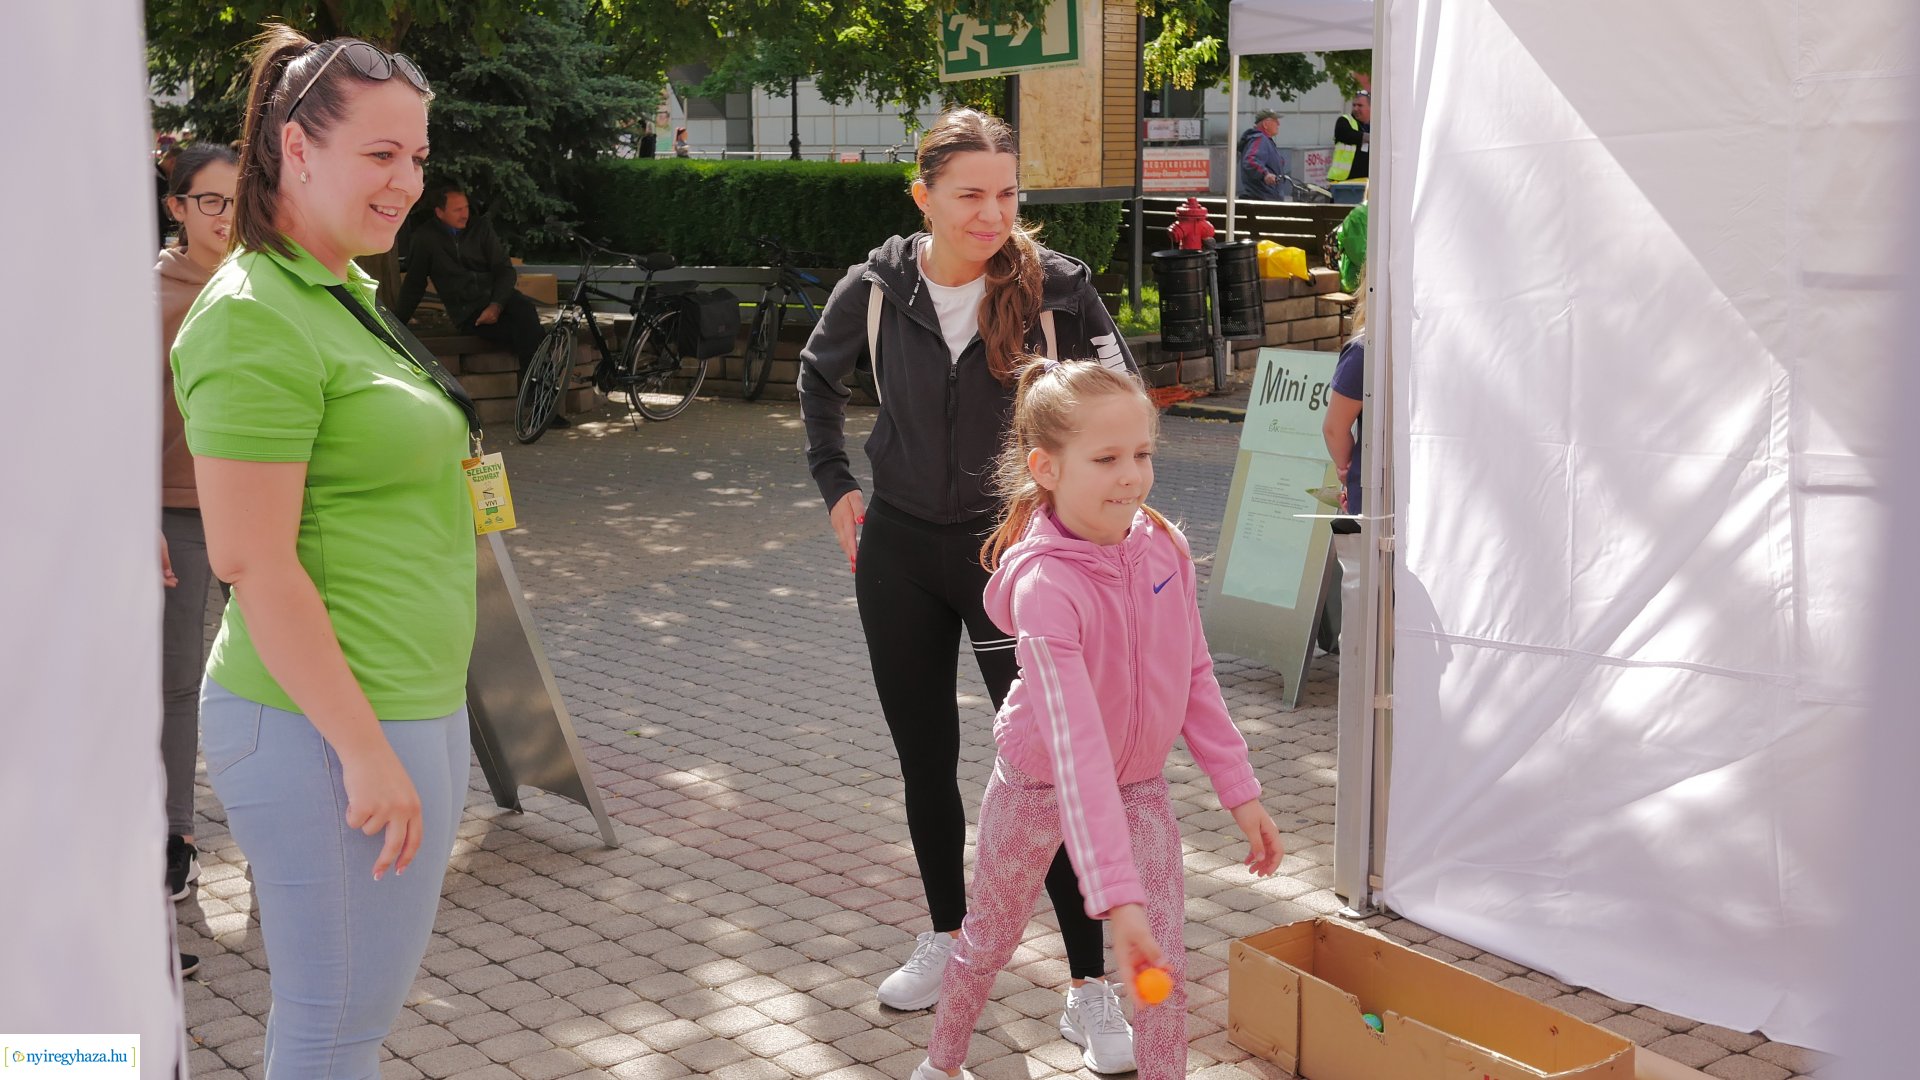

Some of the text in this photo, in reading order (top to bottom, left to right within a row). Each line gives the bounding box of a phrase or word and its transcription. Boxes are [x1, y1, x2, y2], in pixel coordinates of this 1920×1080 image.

[1259, 360, 1308, 406] Mini
[466, 463, 502, 476] SZELEKTÍV
[472, 471, 500, 483] SZOMBAT
[484, 499, 498, 507] VIVI
